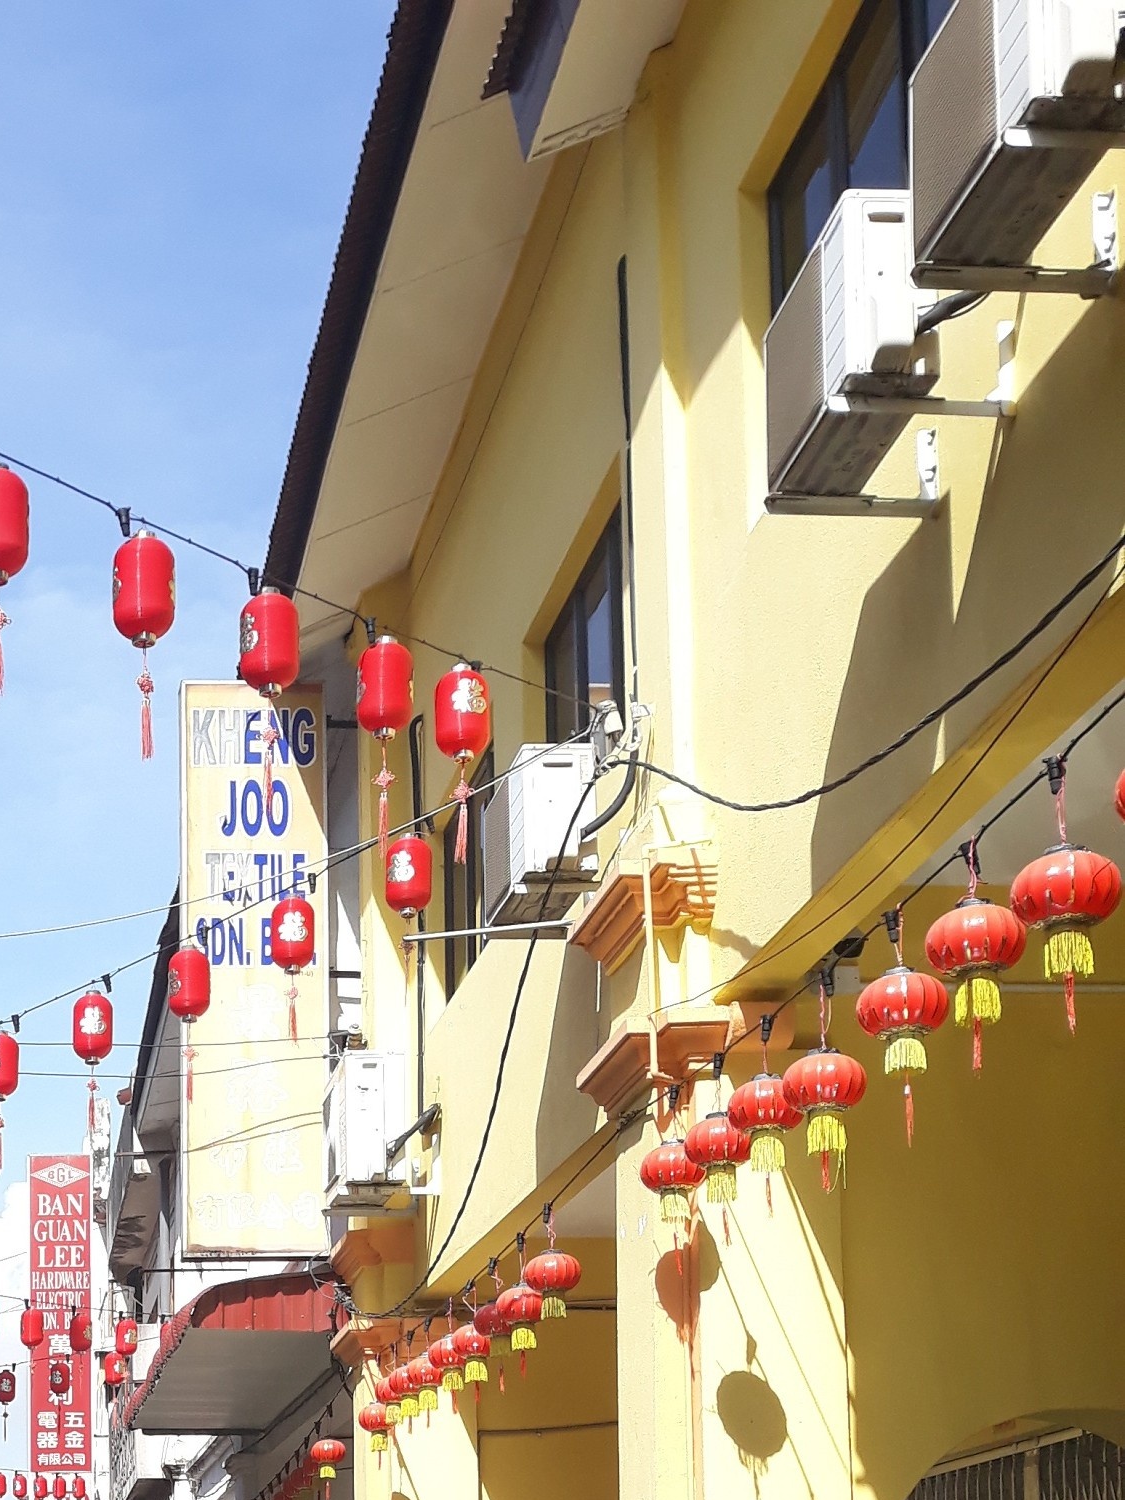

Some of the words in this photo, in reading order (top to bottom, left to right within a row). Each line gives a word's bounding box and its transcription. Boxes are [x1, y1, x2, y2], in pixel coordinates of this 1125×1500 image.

[193, 707, 316, 766] KHENG
[221, 779, 289, 837] JOO
[205, 853, 307, 901] TEXTILE
[48, 1167, 74, 1183] BGL
[37, 1193, 84, 1217] BAN
[33, 1219, 88, 1243] GUAN
[37, 1245, 85, 1268] LEE
[32, 1271, 90, 1290] HARDWARE
[48, 1333, 74, 1406] 萬利
[37, 1453, 86, 1466] 有限公司
